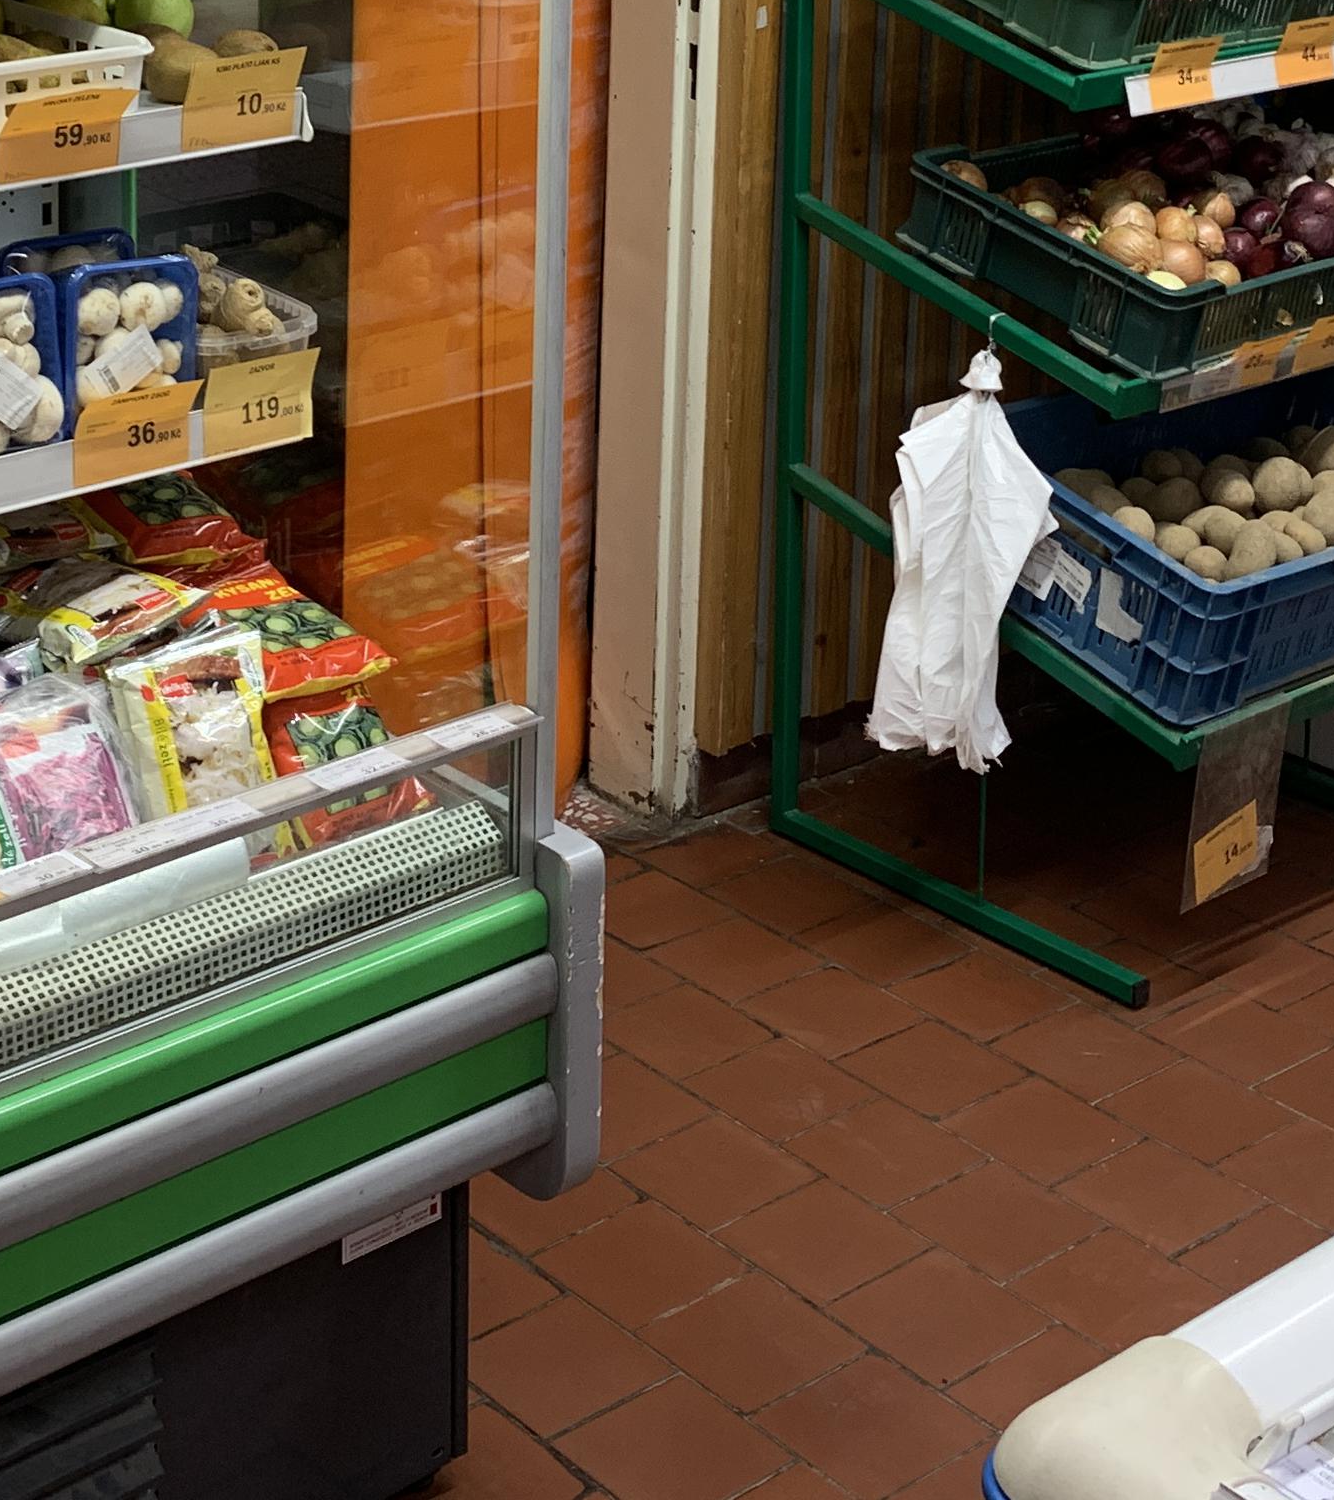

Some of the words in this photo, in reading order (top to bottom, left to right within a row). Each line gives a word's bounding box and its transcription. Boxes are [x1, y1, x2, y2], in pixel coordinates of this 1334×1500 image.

[100, 132, 112, 143] Kč
[171, 428, 181, 439] Kč
[215, 579, 280, 601] KYSAN
